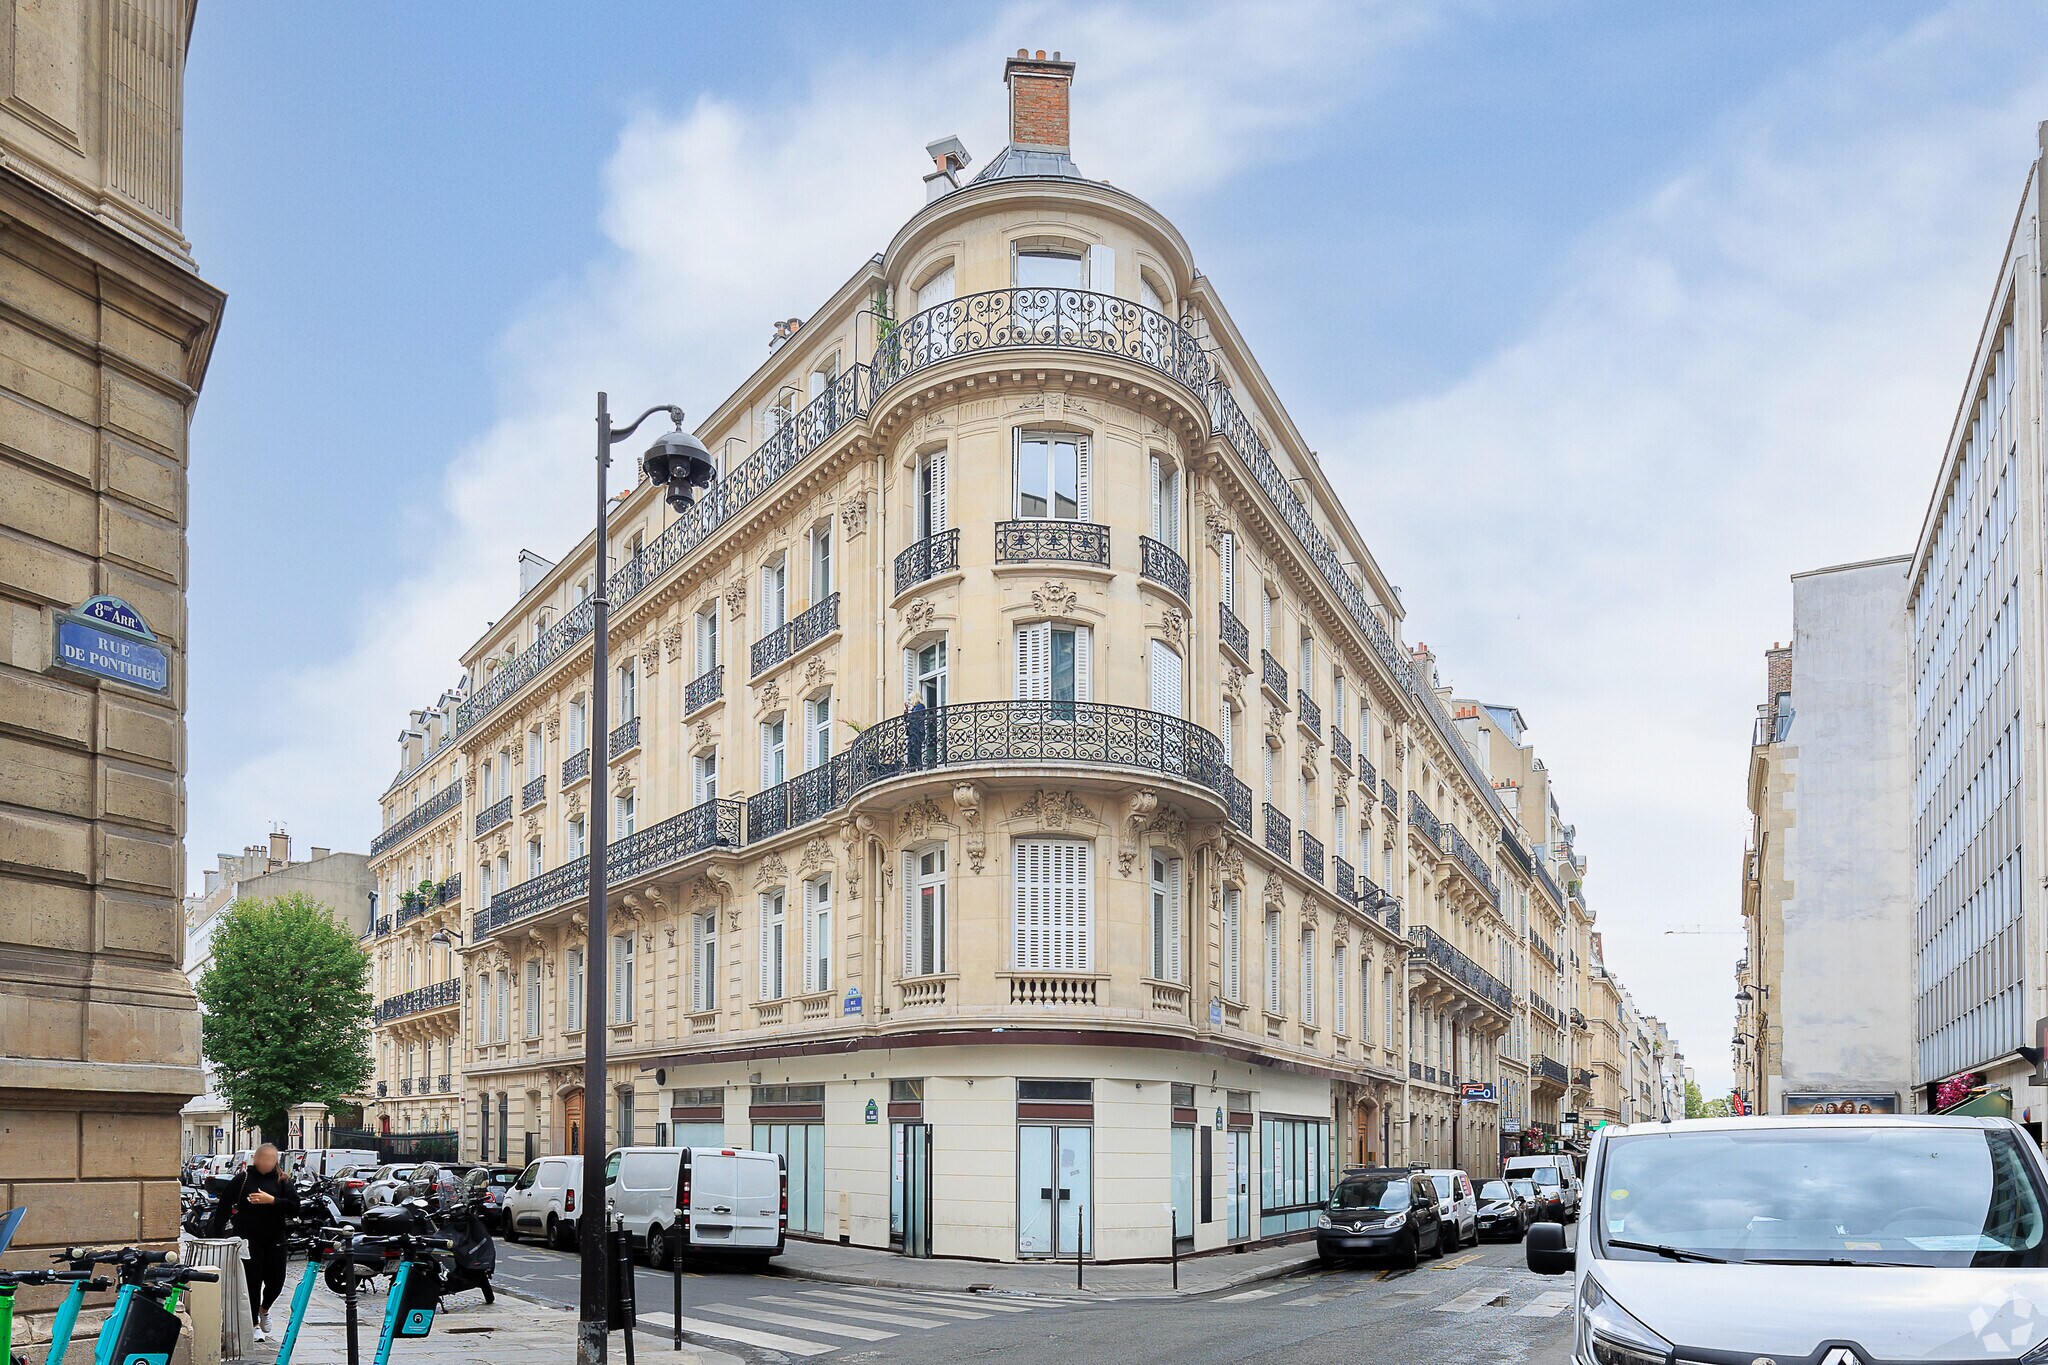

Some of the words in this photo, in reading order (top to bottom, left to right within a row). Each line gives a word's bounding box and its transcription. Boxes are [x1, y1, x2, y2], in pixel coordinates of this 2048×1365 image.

[97, 637, 131, 658] RUE
[64, 644, 86, 661] DE
[89, 651, 161, 683] PONTHIEU
